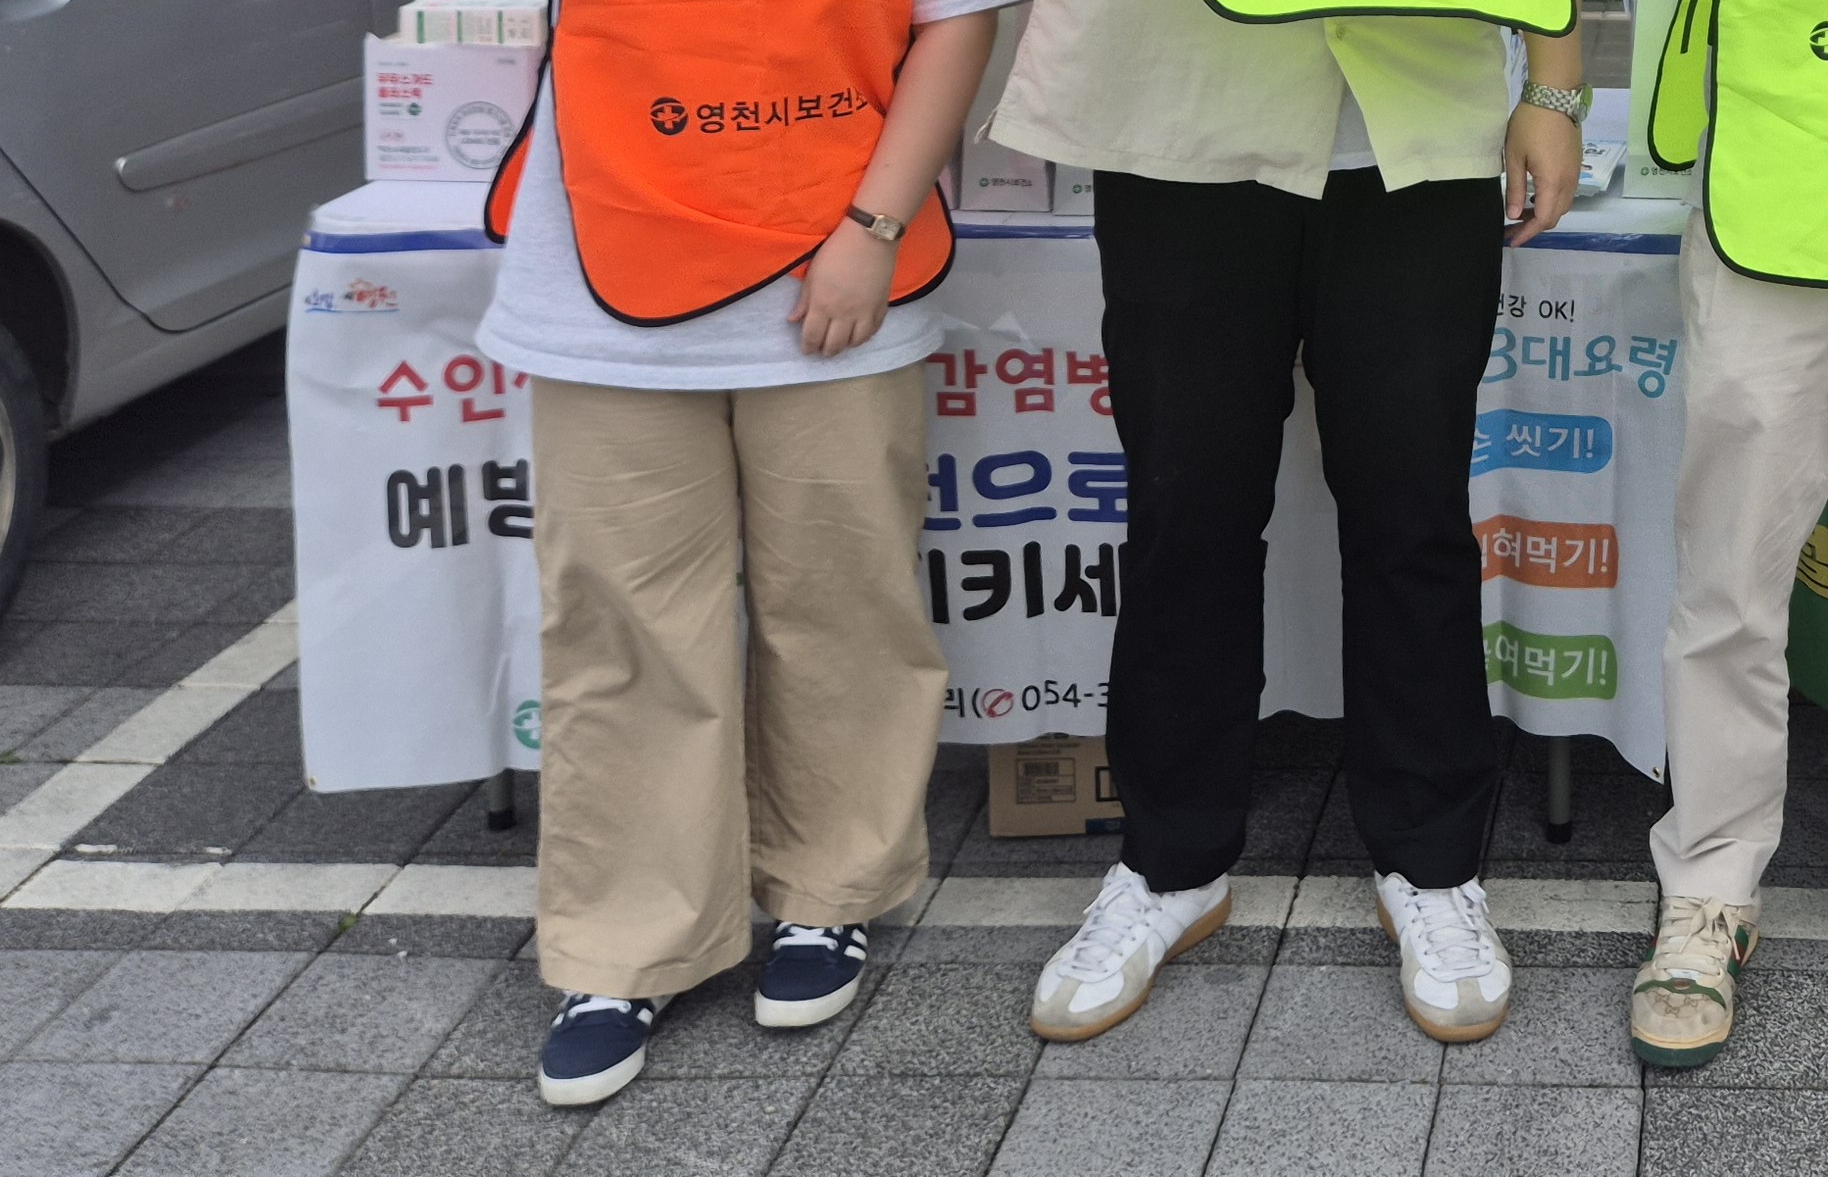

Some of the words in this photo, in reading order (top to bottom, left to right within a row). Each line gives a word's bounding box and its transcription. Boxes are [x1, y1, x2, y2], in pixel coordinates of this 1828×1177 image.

[1539, 300, 1575, 323] OK!
[377, 354, 530, 422] 수인
[925, 348, 1113, 416] 감염병
[1506, 424, 1594, 459] 씻기!
